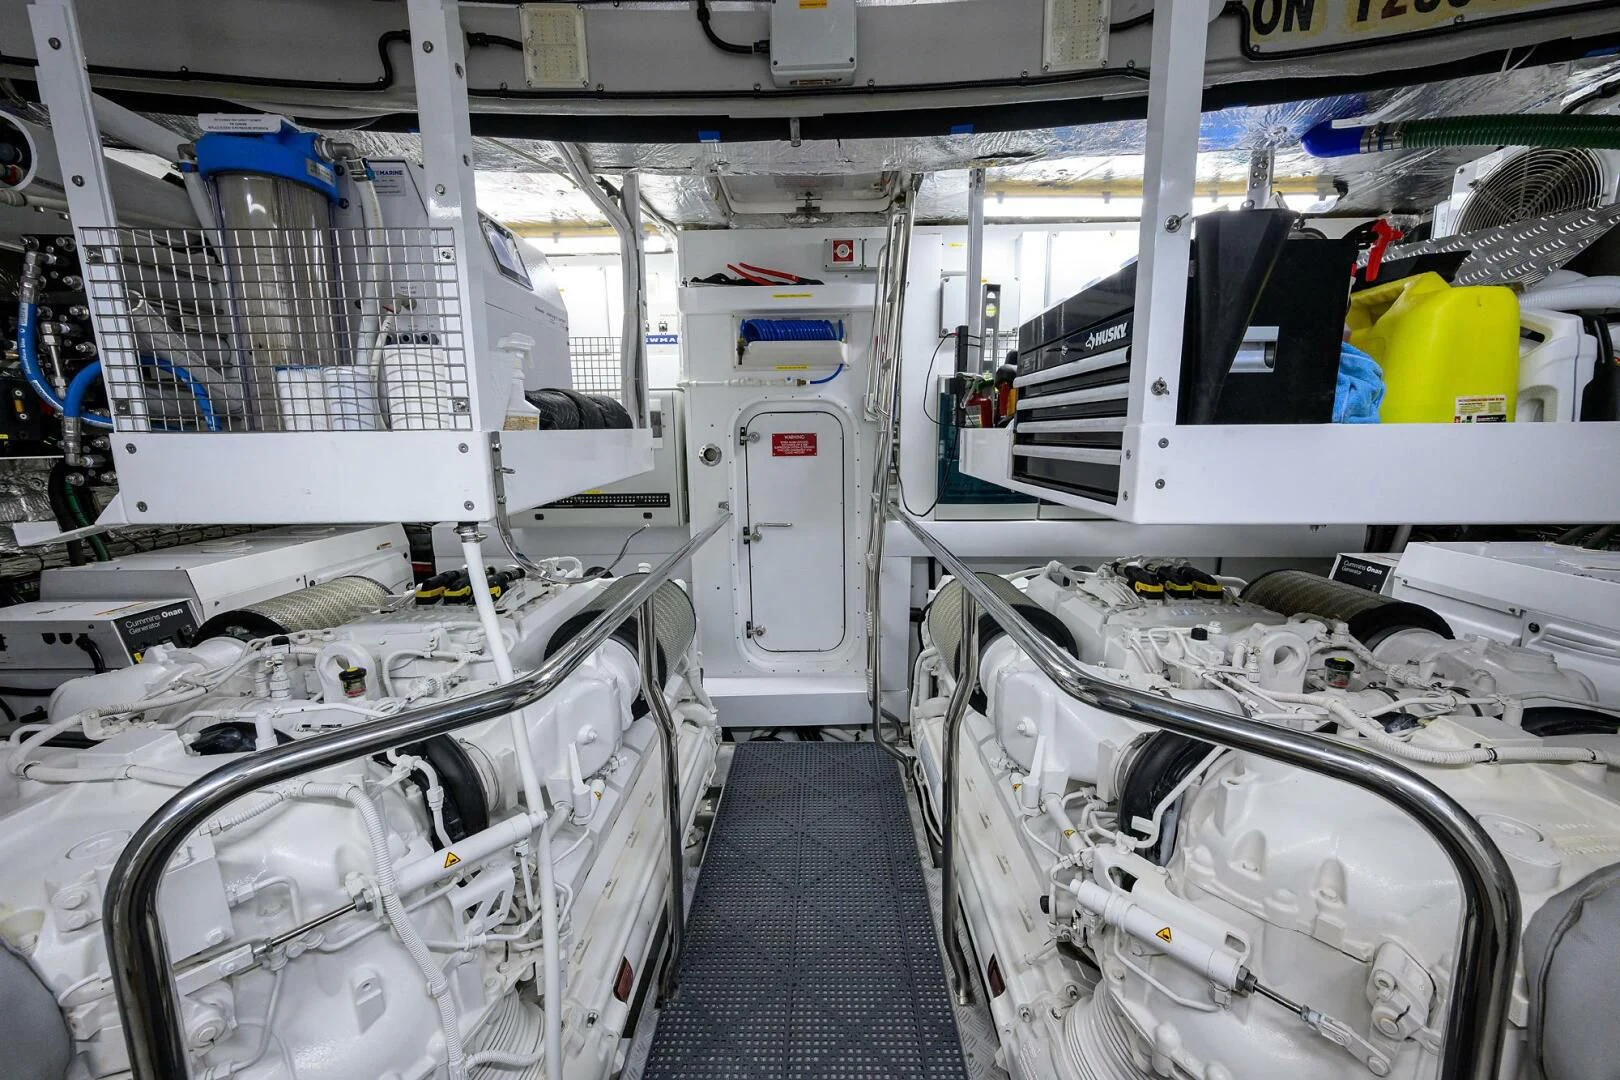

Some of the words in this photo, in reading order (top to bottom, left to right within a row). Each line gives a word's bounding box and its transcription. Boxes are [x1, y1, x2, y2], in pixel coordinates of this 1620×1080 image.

[1253, 0, 1315, 35] ON
[1095, 321, 1128, 346] HUSKY
[1341, 566, 1362, 575] Generator
[1343, 560, 1366, 571] Cummins
[1366, 566, 1383, 575] Onan
[125, 614, 161, 629] Cummins
[161, 608, 183, 618] Onan
[128, 622, 161, 635] Generator
